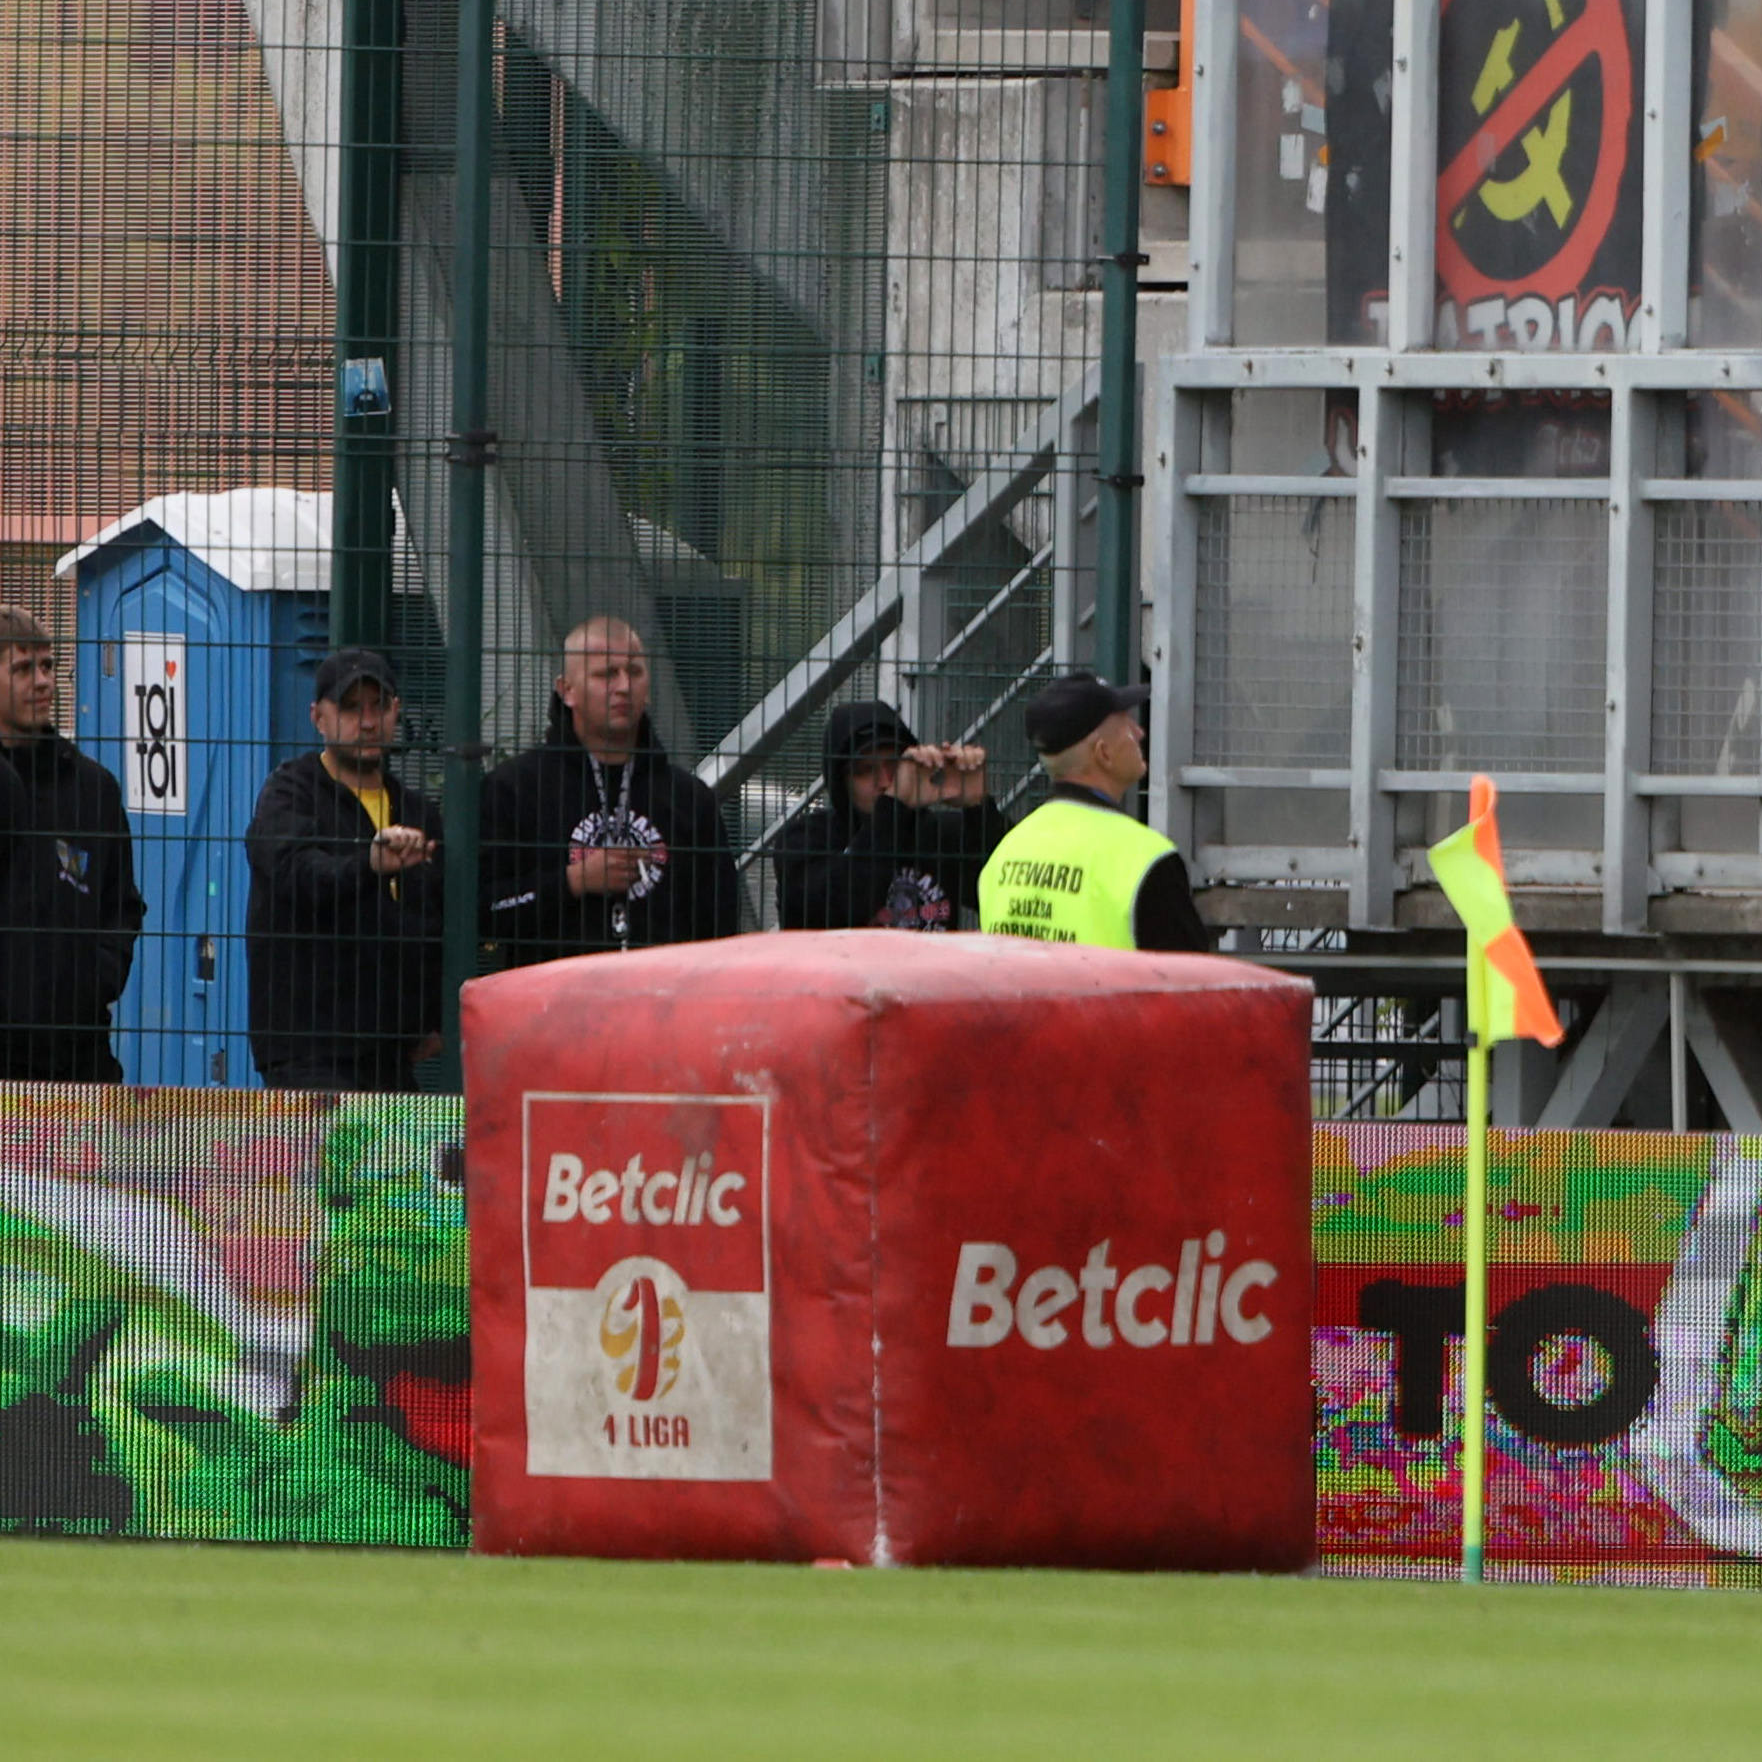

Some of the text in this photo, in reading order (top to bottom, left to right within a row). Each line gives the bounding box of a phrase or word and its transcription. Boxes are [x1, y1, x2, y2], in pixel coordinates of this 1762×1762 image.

[134, 683, 175, 740] TOI
[136, 741, 177, 798] TOI
[998, 861, 1084, 894] STEWARD
[1008, 896, 1053, 919] SŁUŻBA
[542, 1152, 745, 1227] Betclic
[947, 1231, 1280, 1351] Betclic
[1359, 1280, 1661, 1447] TO
[603, 1416, 690, 1449] 1 LIGA
